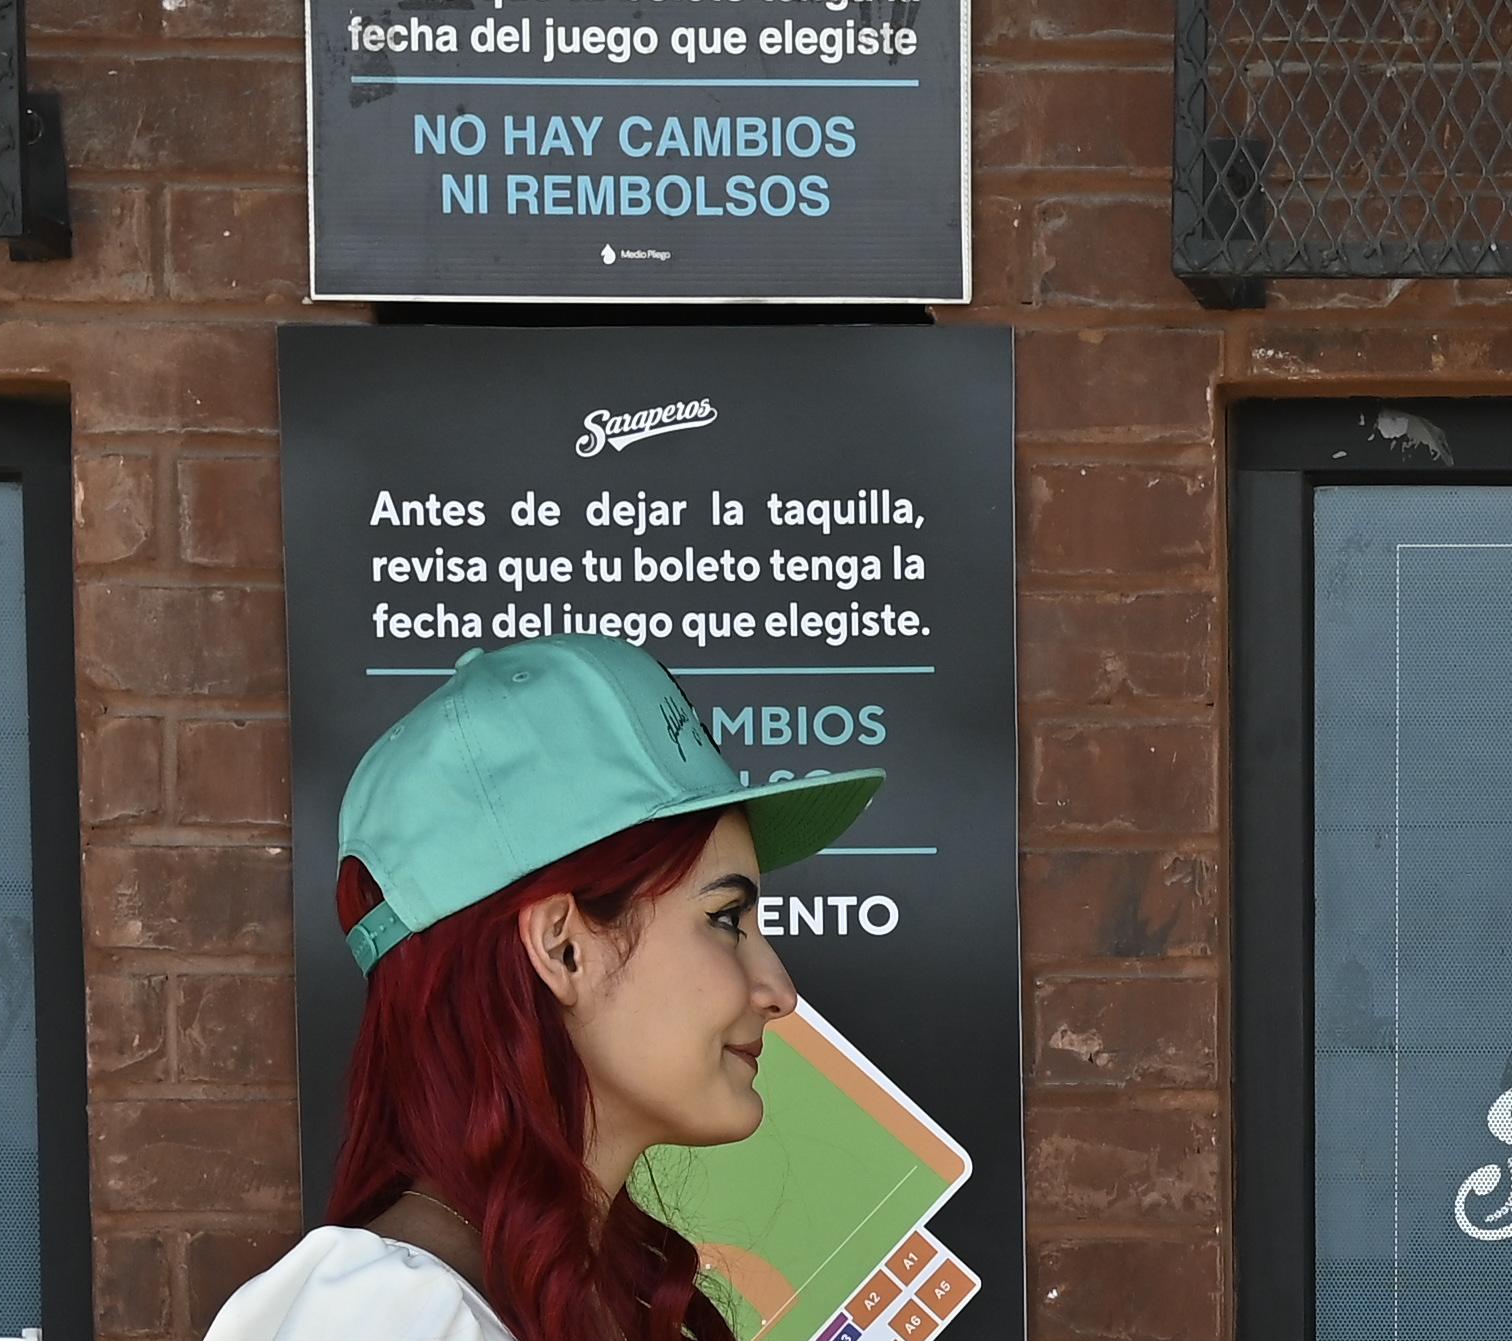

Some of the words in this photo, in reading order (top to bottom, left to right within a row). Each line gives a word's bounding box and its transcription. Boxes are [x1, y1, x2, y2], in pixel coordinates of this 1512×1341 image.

[348, 17, 458, 54] fecha
[470, 17, 531, 53] del
[543, 19, 659, 62] juego
[671, 24, 747, 63] que
[758, 20, 918, 64] elegiste
[413, 114, 486, 156] NO
[503, 115, 604, 157] HAY
[618, 115, 857, 159] CAMBIOS
[441, 174, 488, 215] NI
[506, 175, 831, 218] REMBOLSOS
[575, 397, 718, 458] Saraperos
[370, 490, 487, 527] Antes
[510, 491, 561, 527] de
[585, 491, 687, 535] dejar
[711, 490, 744, 526] la
[766, 489, 925, 534] taquilla,
[371, 548, 488, 582] revisa
[497, 555, 574, 592] que
[581, 551, 623, 582] tu
[634, 547, 761, 582] boleto
[769, 549, 881, 590] tenga
[893, 546, 926, 581] la
[372, 603, 482, 638] fecha
[491, 603, 551, 638] del
[682, 611, 757, 647] que
[764, 600, 932, 647] elegiste.
[712, 705, 887, 746] MBIOS
[758, 894, 900, 937] ENTO
[902, 1252, 919, 1271] A1
[863, 1291, 881, 1311] A2
[934, 1280, 951, 1300] A5
[904, 1315, 922, 1335] A6
